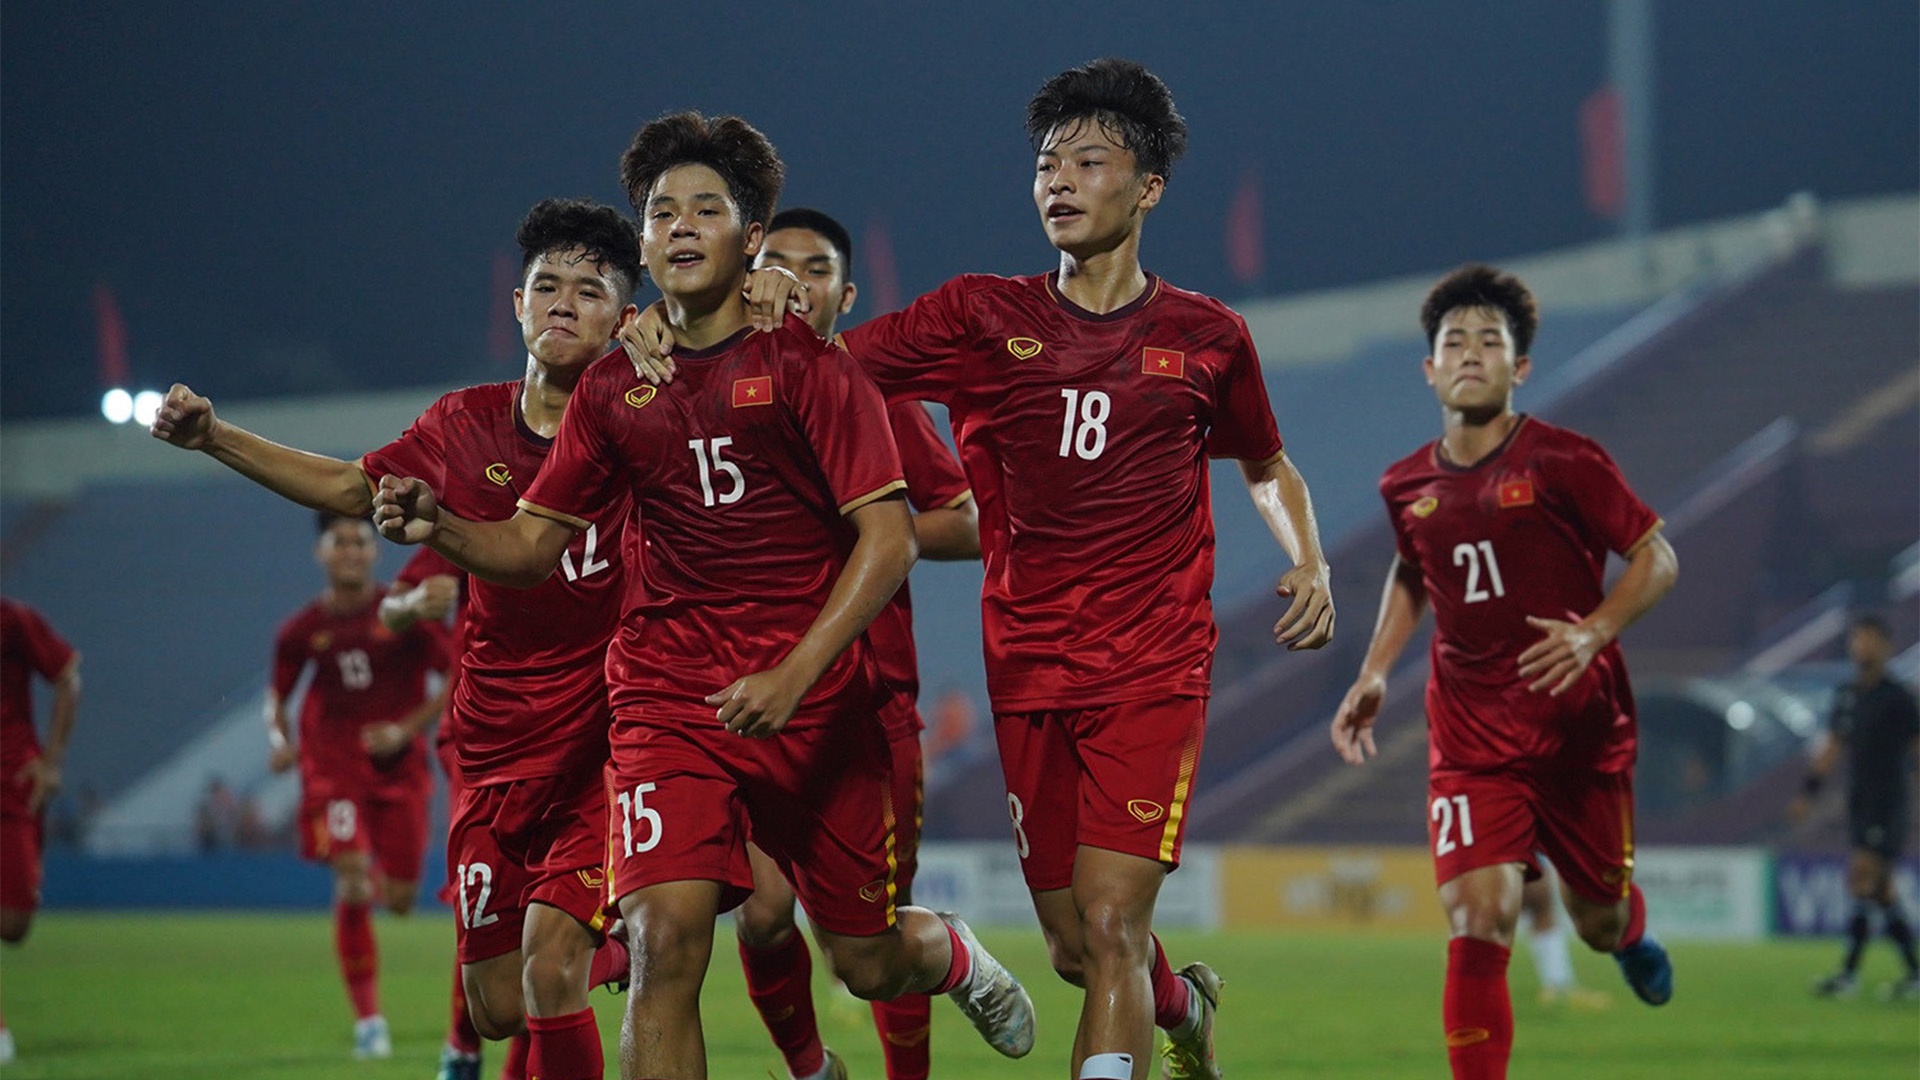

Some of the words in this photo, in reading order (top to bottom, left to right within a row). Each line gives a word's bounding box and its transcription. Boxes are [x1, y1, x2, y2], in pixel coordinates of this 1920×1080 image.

[1060, 388, 1111, 460] 18
[688, 436, 746, 507] 15
[1453, 540, 1505, 604] 21
[617, 782, 663, 858] 15
[1431, 795, 1474, 857] 21
[457, 862, 499, 929] 12
